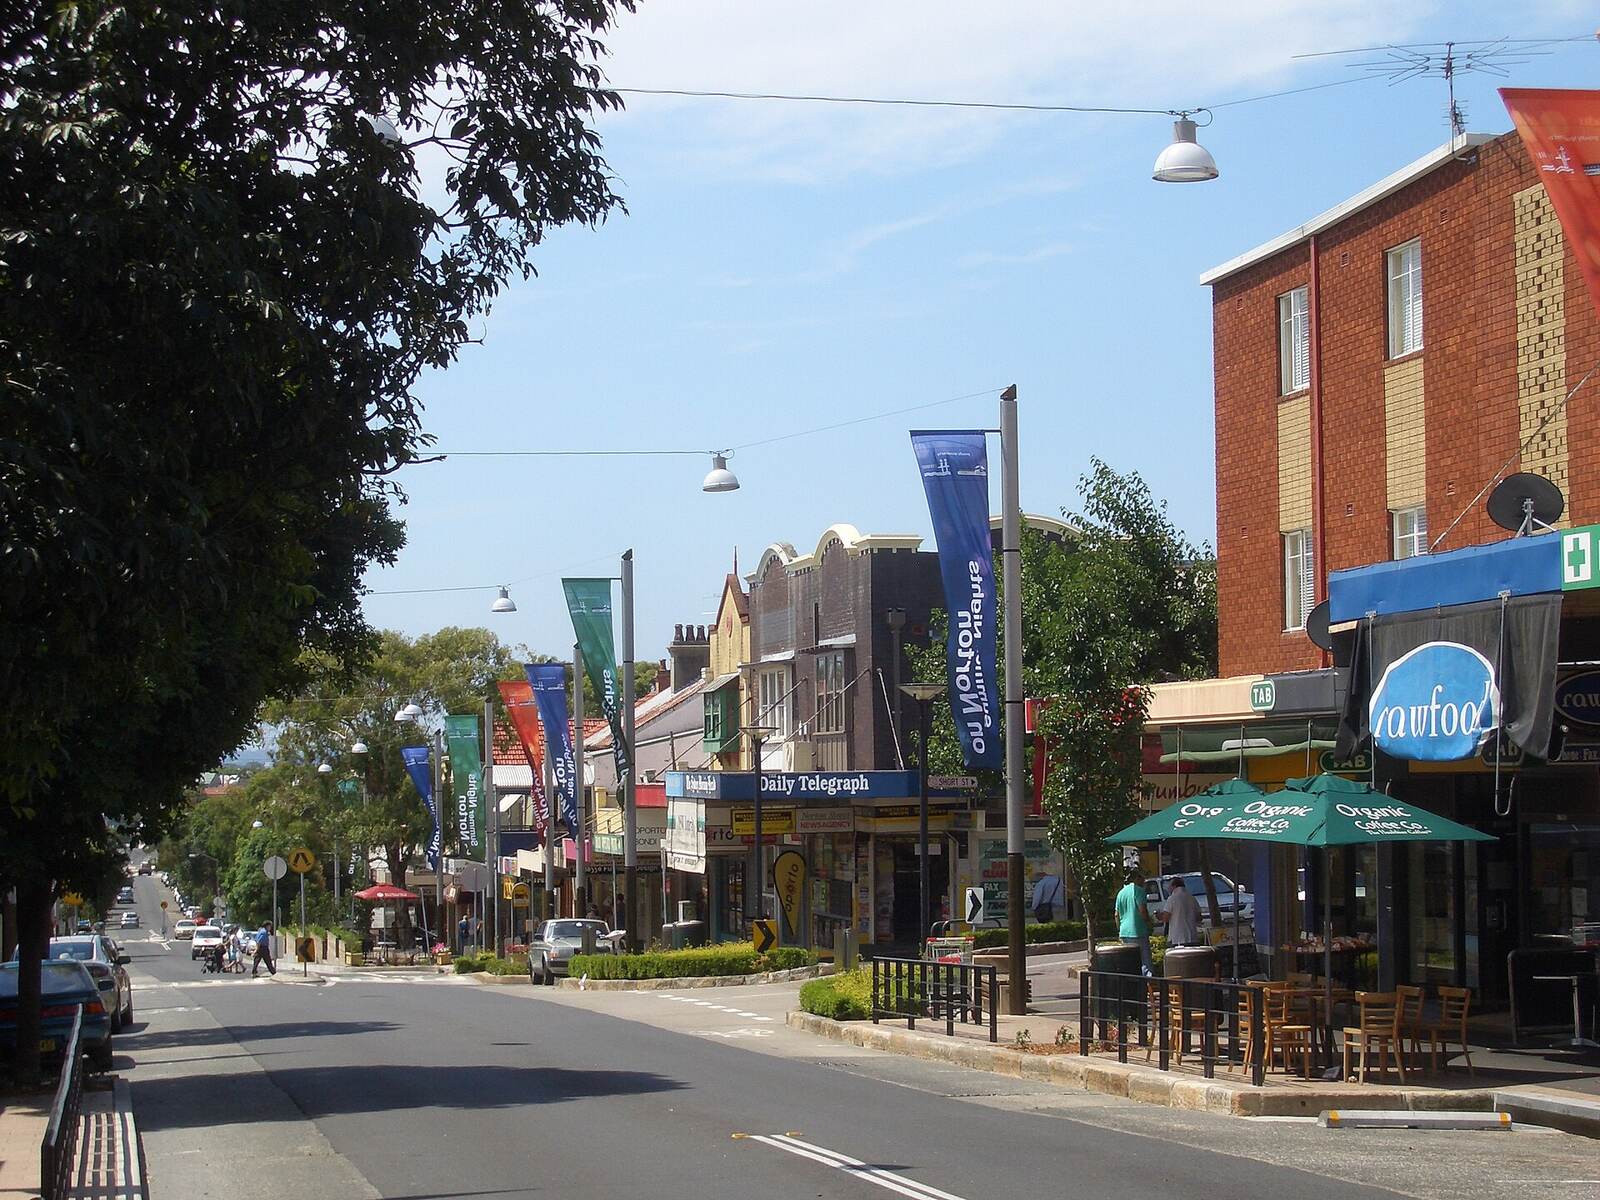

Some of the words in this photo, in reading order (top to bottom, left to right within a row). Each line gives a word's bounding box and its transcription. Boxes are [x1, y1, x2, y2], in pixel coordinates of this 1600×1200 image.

[1252, 686, 1272, 704] TAB
[1375, 680, 1491, 739] rawfood
[760, 774, 796, 796] Daily
[798, 774, 870, 796] Telegraph
[1243, 801, 1314, 818] Organic
[1335, 803, 1412, 820] Organic
[1226, 817, 1270, 828] Coffee
[1270, 818, 1290, 829] Co.
[1354, 820, 1401, 831] Coffee
[1400, 821, 1428, 831] Co.
[983, 882, 999, 892] FAX
